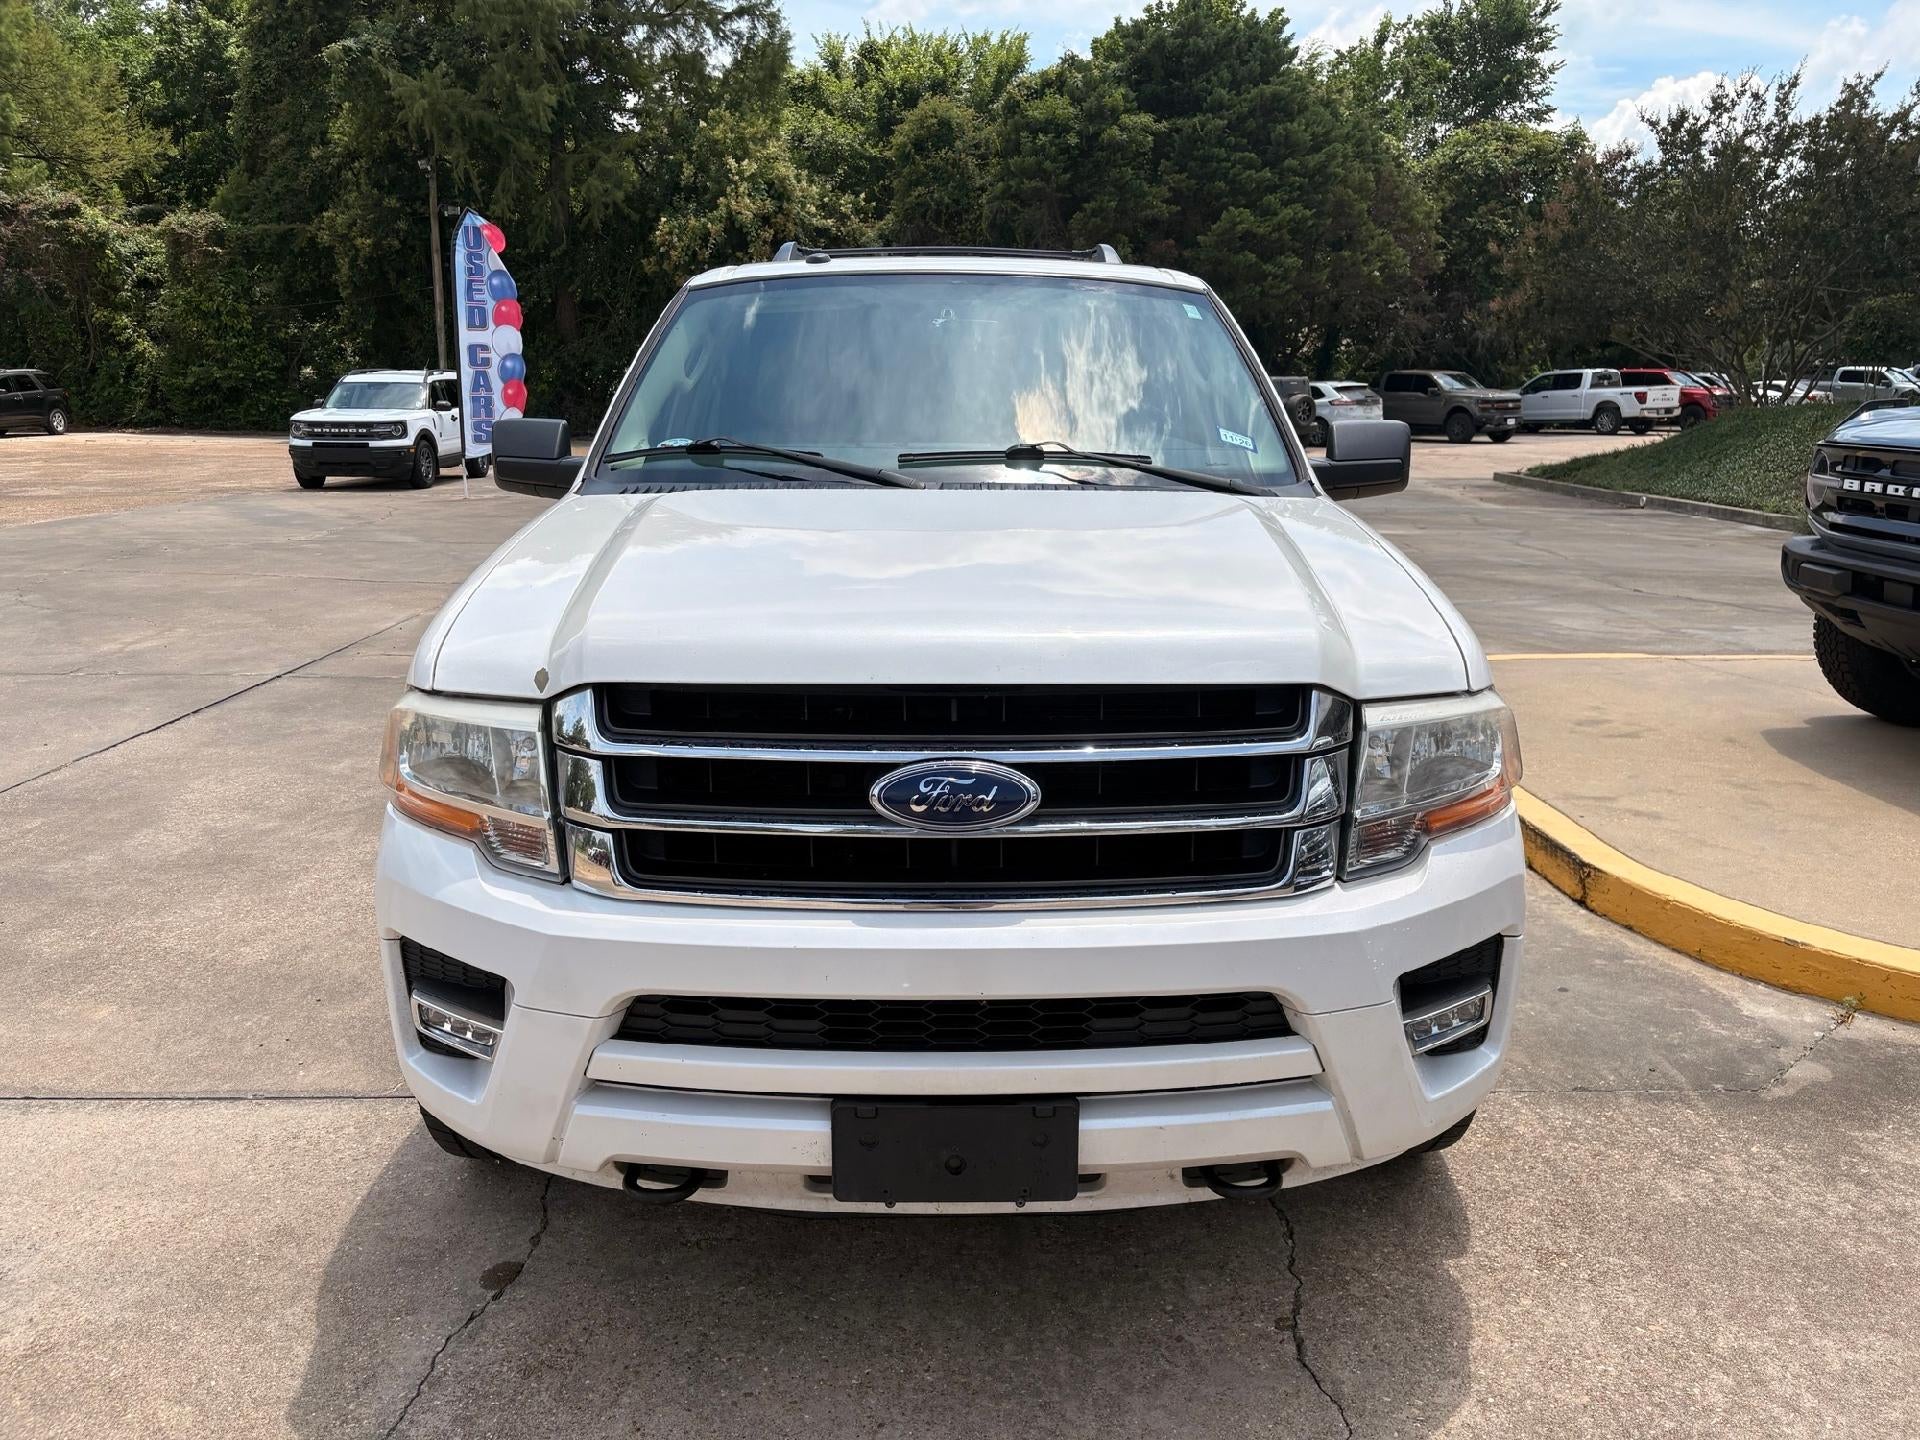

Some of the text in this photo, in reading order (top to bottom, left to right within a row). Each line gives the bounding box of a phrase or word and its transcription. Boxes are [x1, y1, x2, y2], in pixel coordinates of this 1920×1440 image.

[463, 225, 495, 444] USED CARS
[910, 776, 998, 813] Ford
